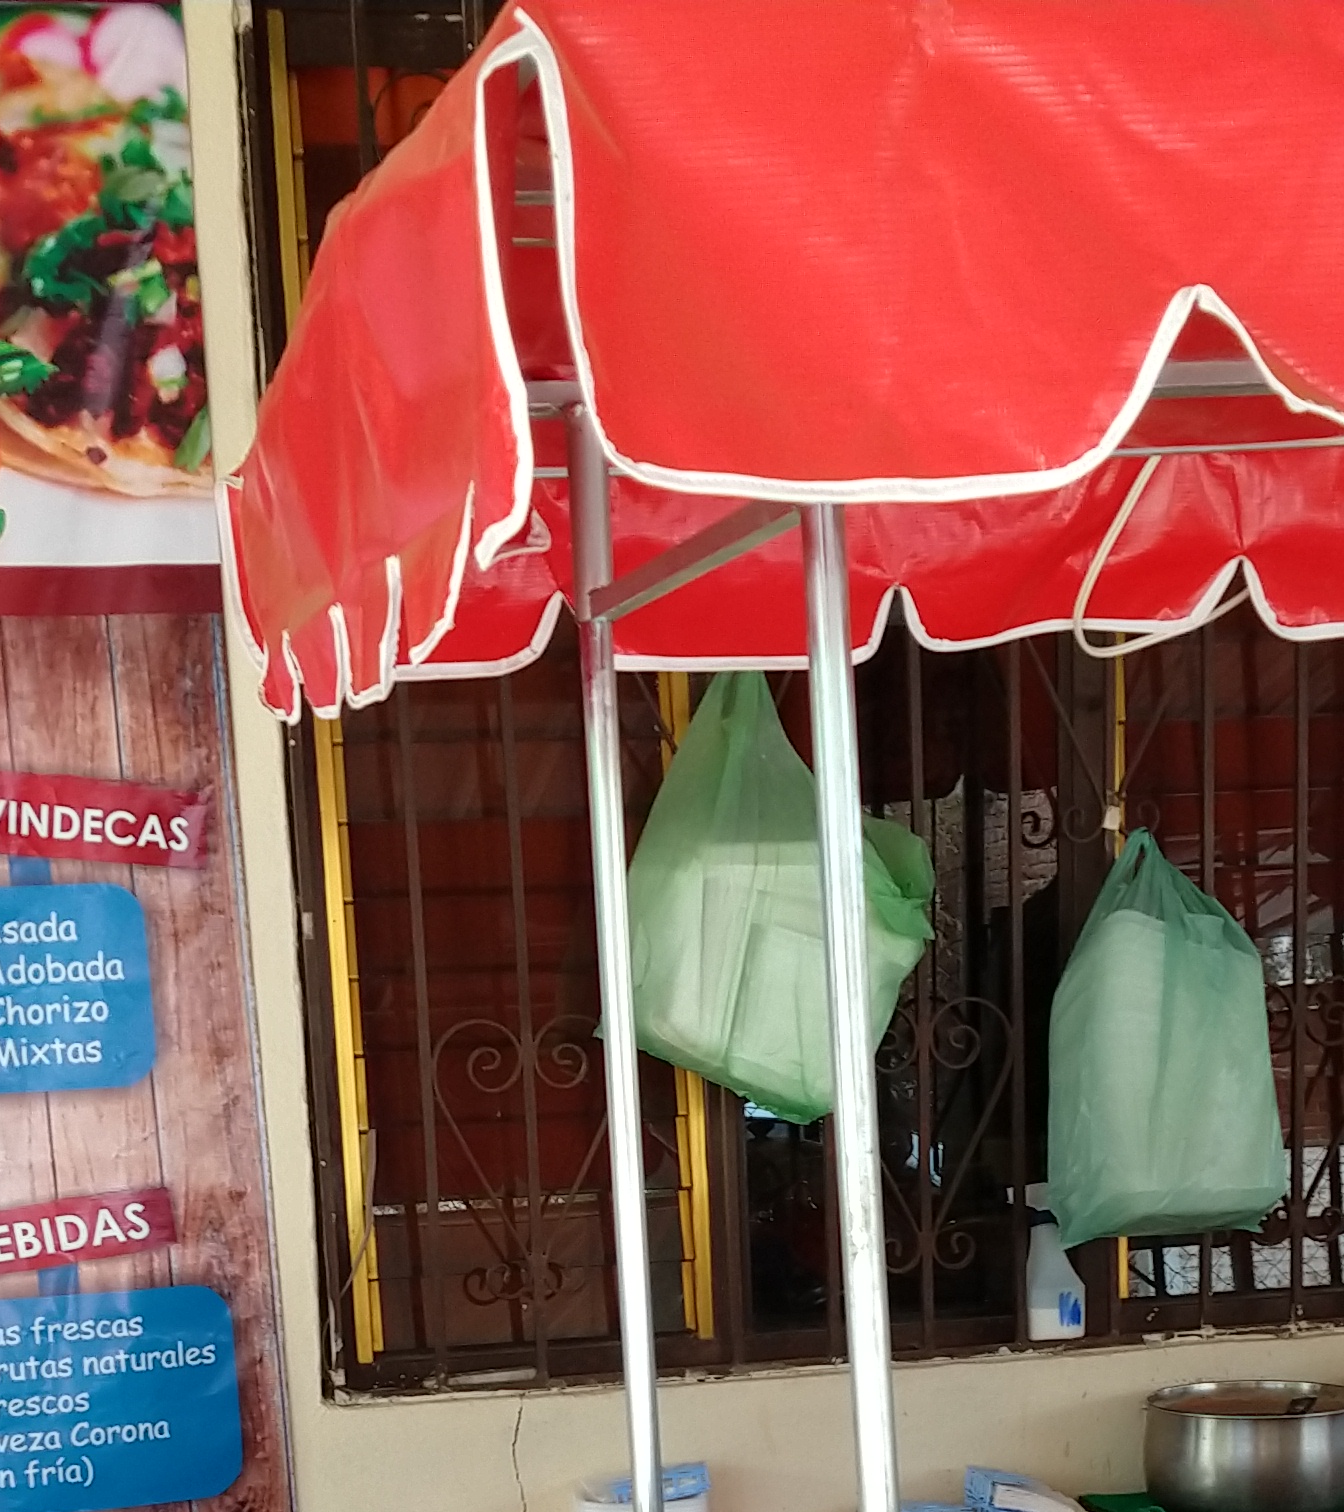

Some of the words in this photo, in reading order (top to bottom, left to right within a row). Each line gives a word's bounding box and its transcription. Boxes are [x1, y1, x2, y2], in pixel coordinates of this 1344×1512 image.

[30, 1314, 144, 1346] frescas
[82, 1340, 216, 1375] naturales
[71, 1416, 170, 1448] Corona
[25, 1452, 96, 1492] fría)
